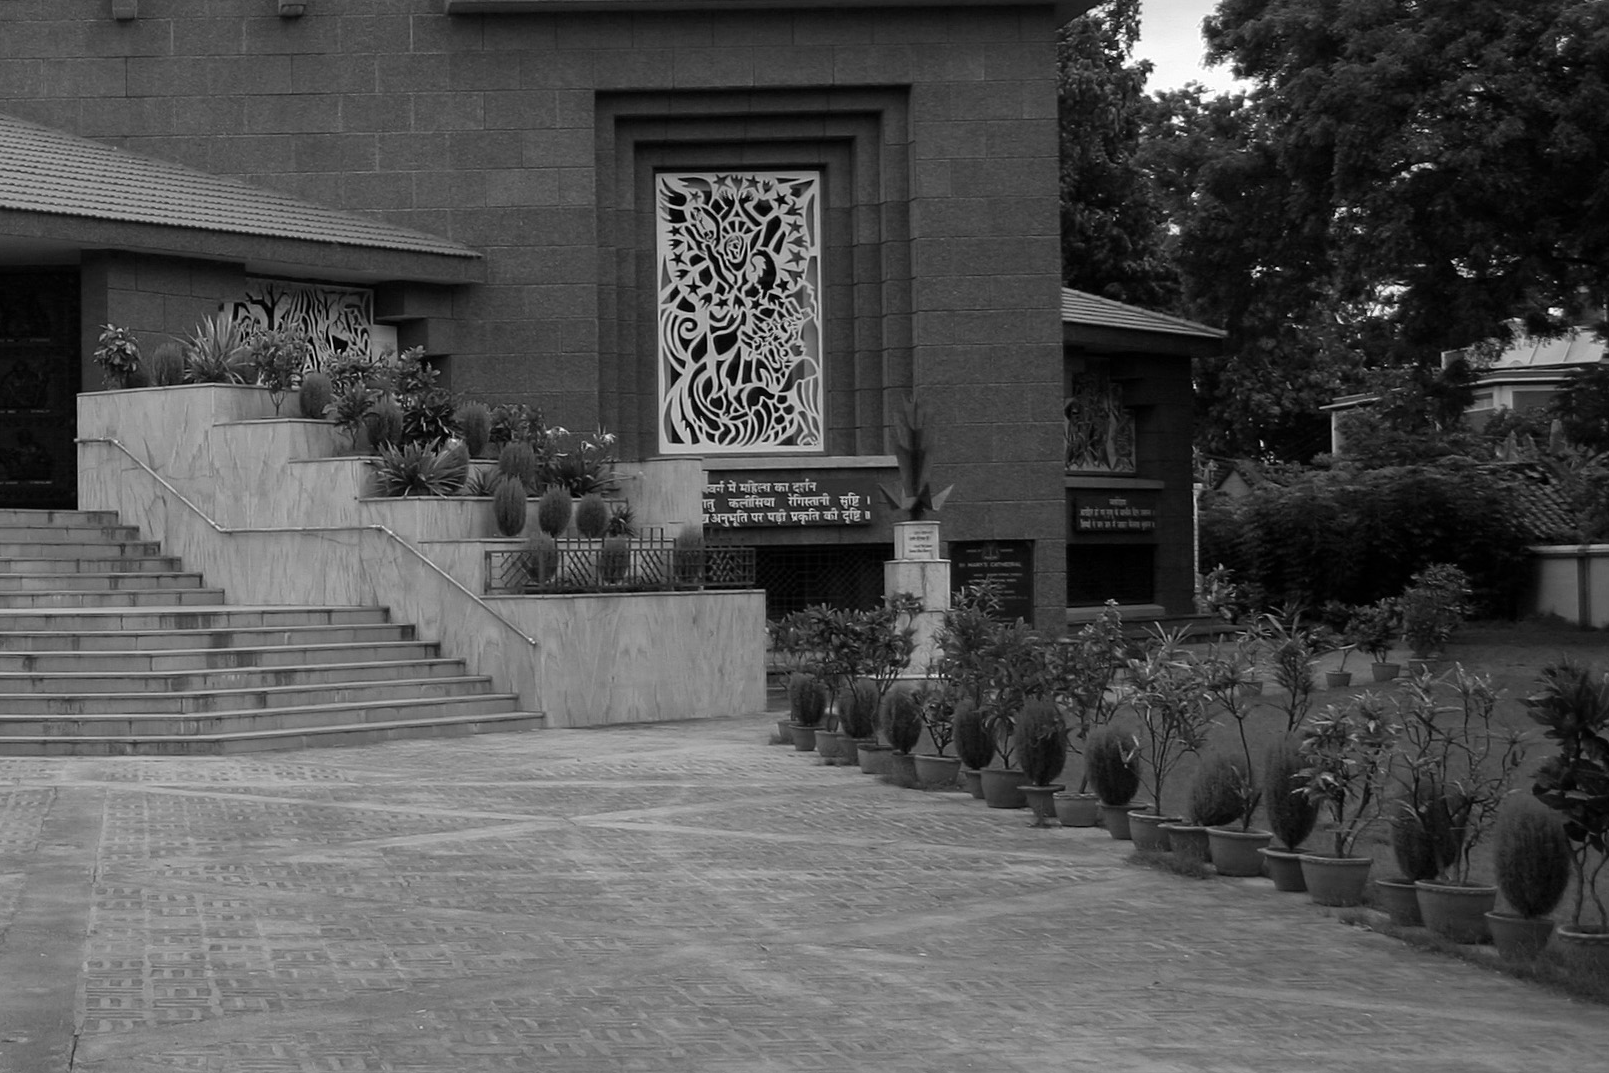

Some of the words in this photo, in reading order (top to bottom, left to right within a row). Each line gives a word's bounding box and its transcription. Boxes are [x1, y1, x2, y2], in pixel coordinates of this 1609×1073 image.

[727, 479, 736, 493] में
[773, 482, 790, 493] का
[749, 512, 765, 523] पर
[822, 507, 839, 520] की
